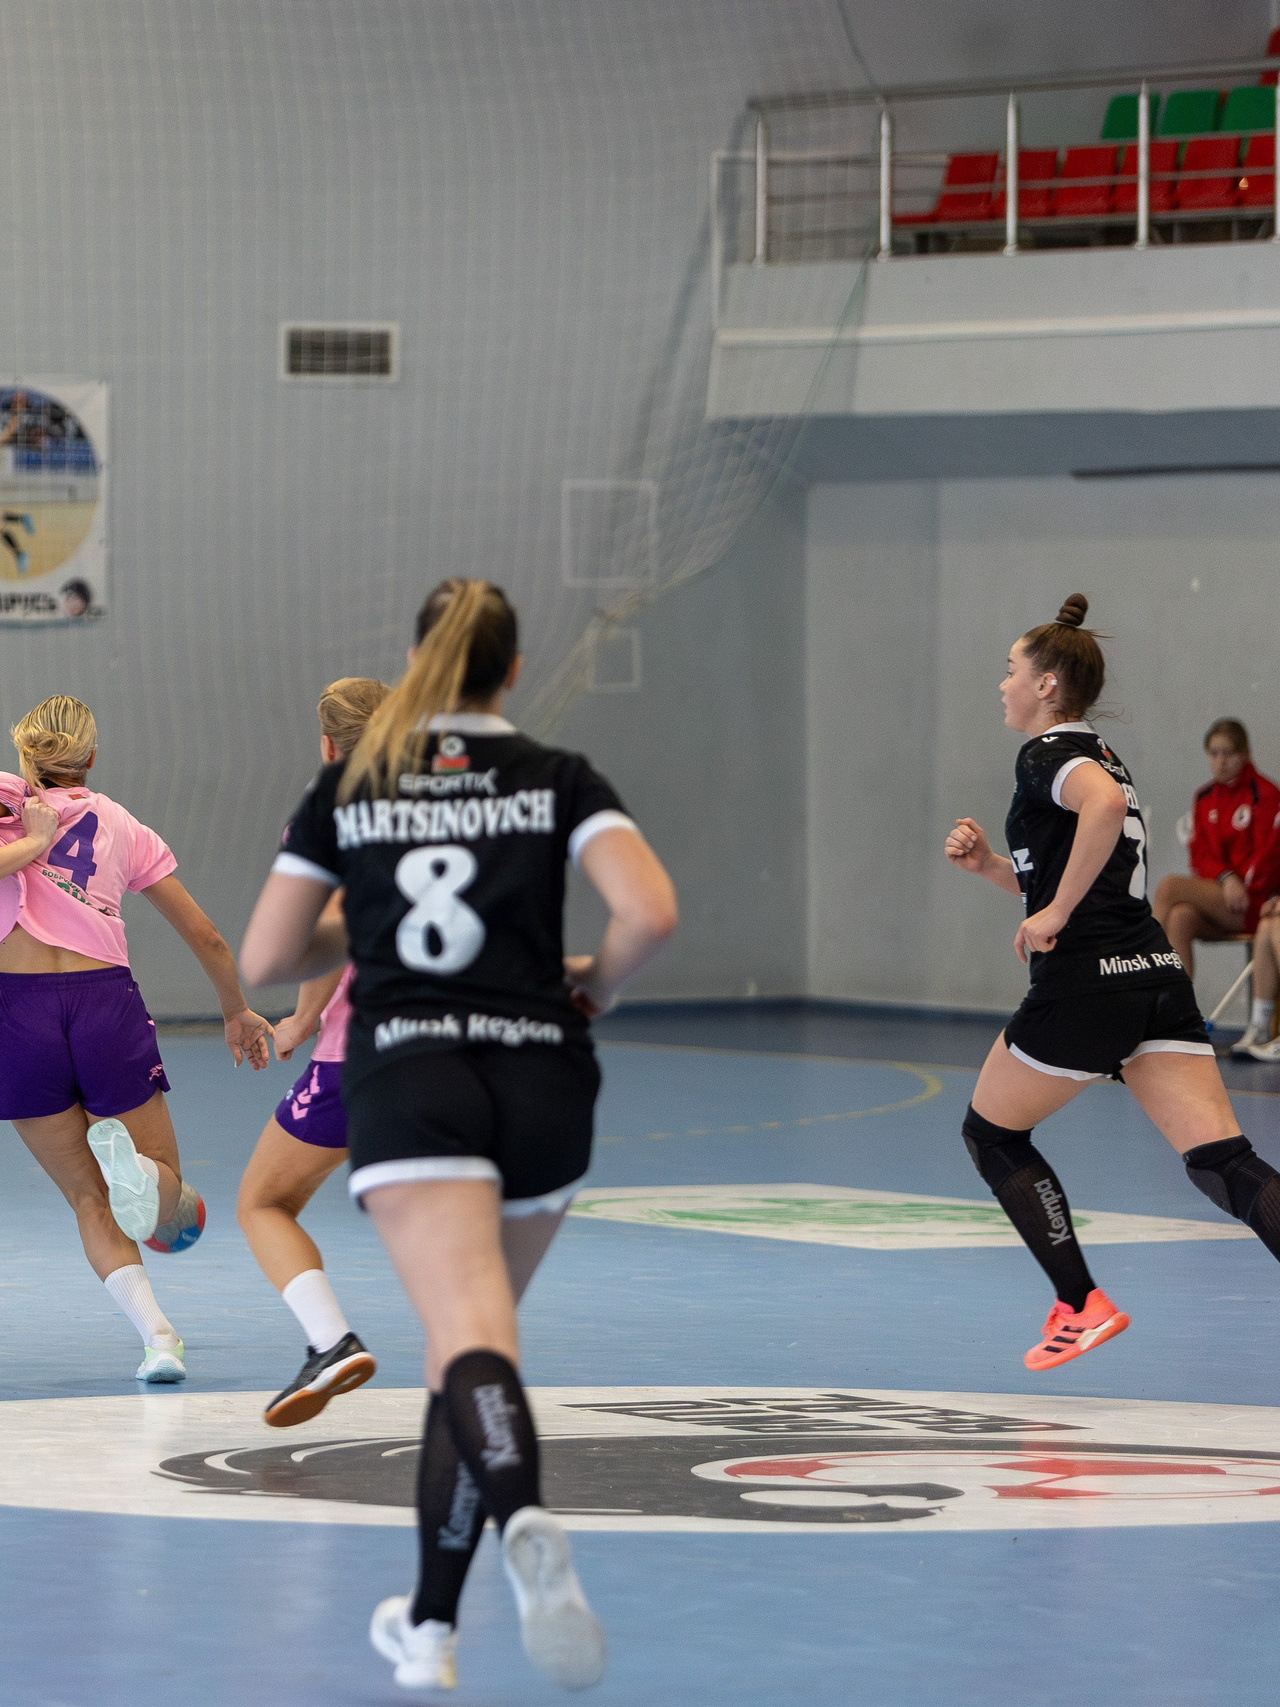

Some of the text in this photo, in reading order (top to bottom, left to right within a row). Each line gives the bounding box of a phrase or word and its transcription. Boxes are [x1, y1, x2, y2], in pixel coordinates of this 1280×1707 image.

[333, 789, 555, 850] MARTSINOVICH
[395, 844, 487, 976] 8
[1099, 954, 1151, 976] Minsk
[375, 1013, 564, 1052] Minsk Region
[1034, 1178, 1072, 1246] Kempa
[472, 1384, 522, 1471] Kempa
